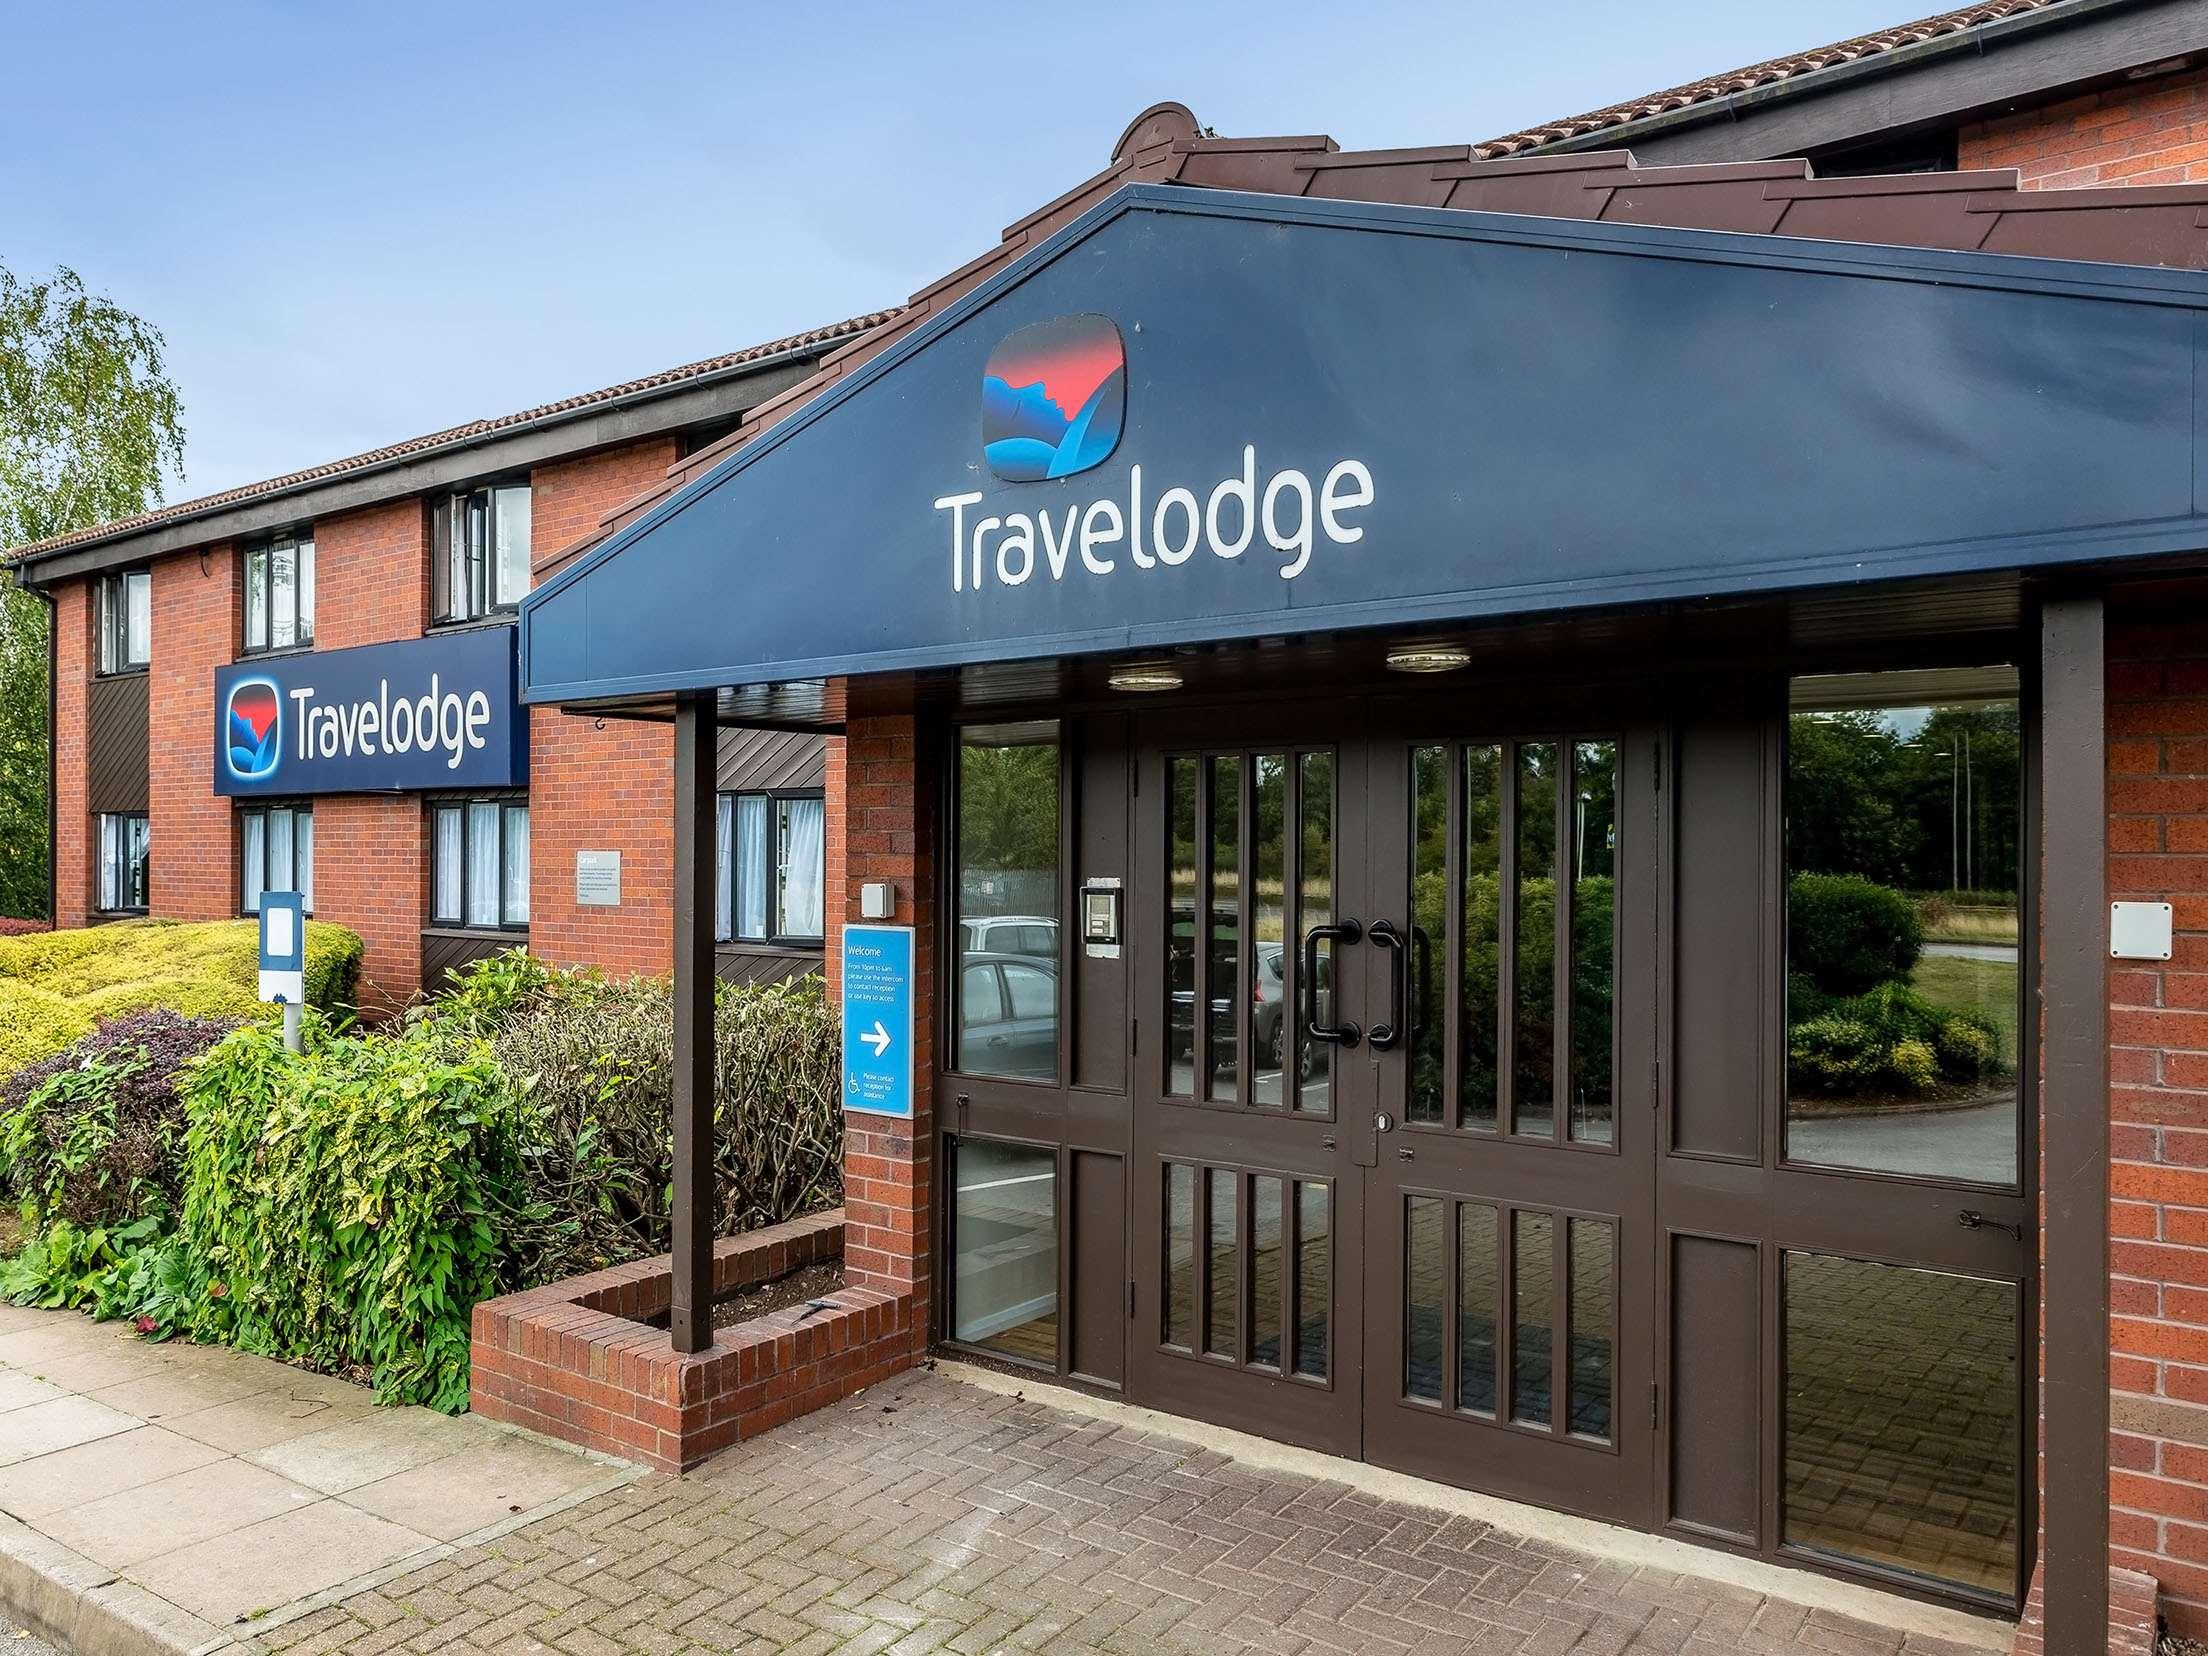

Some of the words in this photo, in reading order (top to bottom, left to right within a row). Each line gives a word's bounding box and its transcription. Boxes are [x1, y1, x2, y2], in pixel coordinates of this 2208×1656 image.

[934, 443, 1375, 593] Travelodge
[289, 672, 490, 770] Travelodge
[848, 945, 881, 957] Welcome
